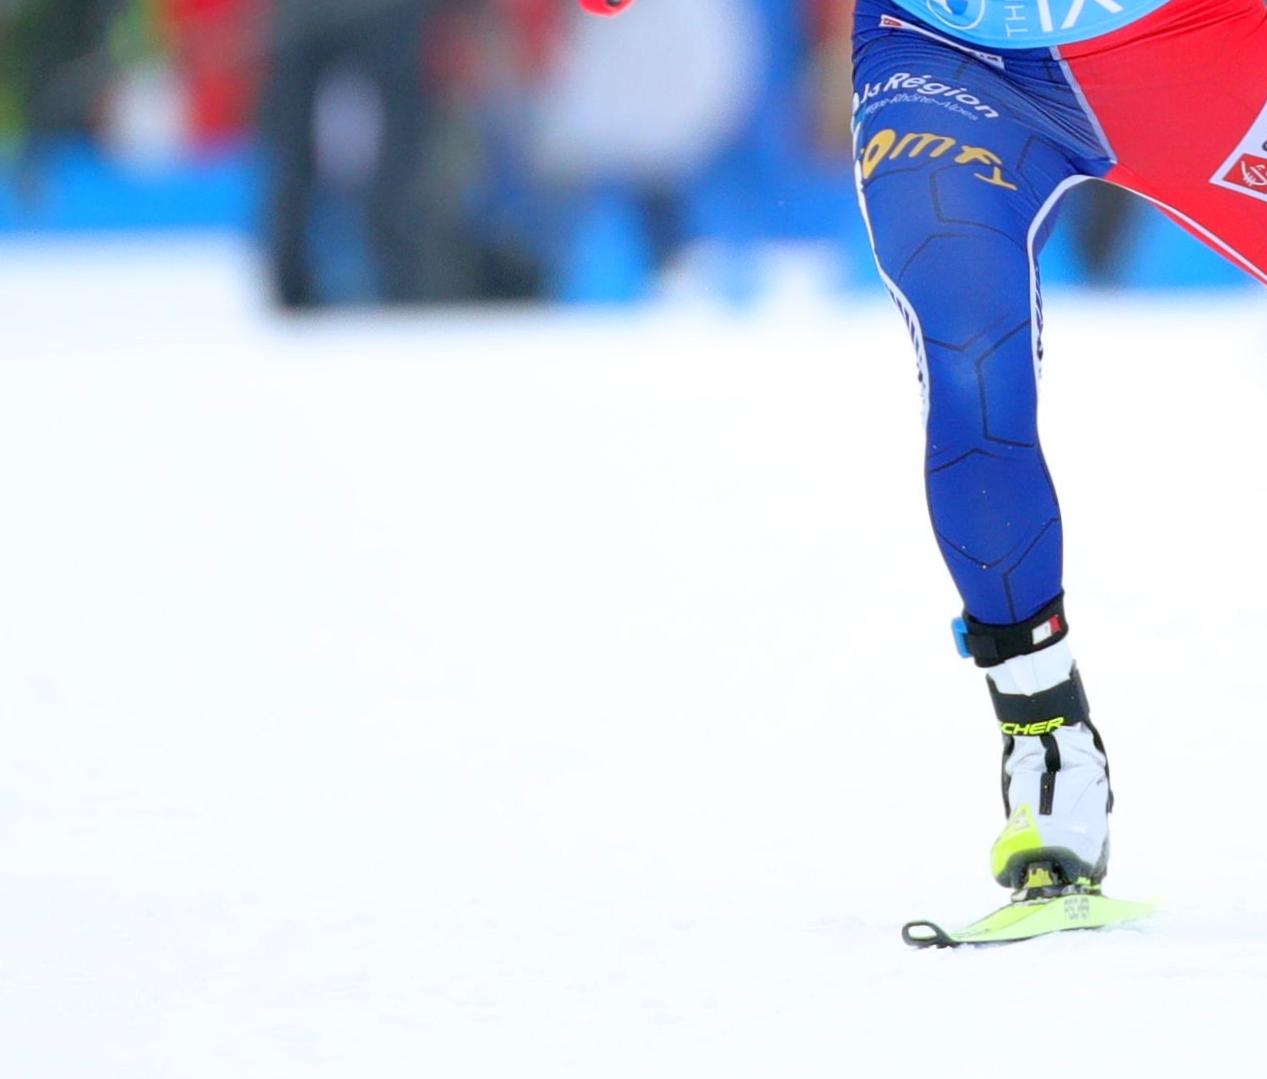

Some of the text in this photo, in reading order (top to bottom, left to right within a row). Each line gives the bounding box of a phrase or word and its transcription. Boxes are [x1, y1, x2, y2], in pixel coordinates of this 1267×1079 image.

[883, 72, 999, 119] Région
[861, 128, 1018, 191] omfy
[998, 716, 1066, 736] CHER
